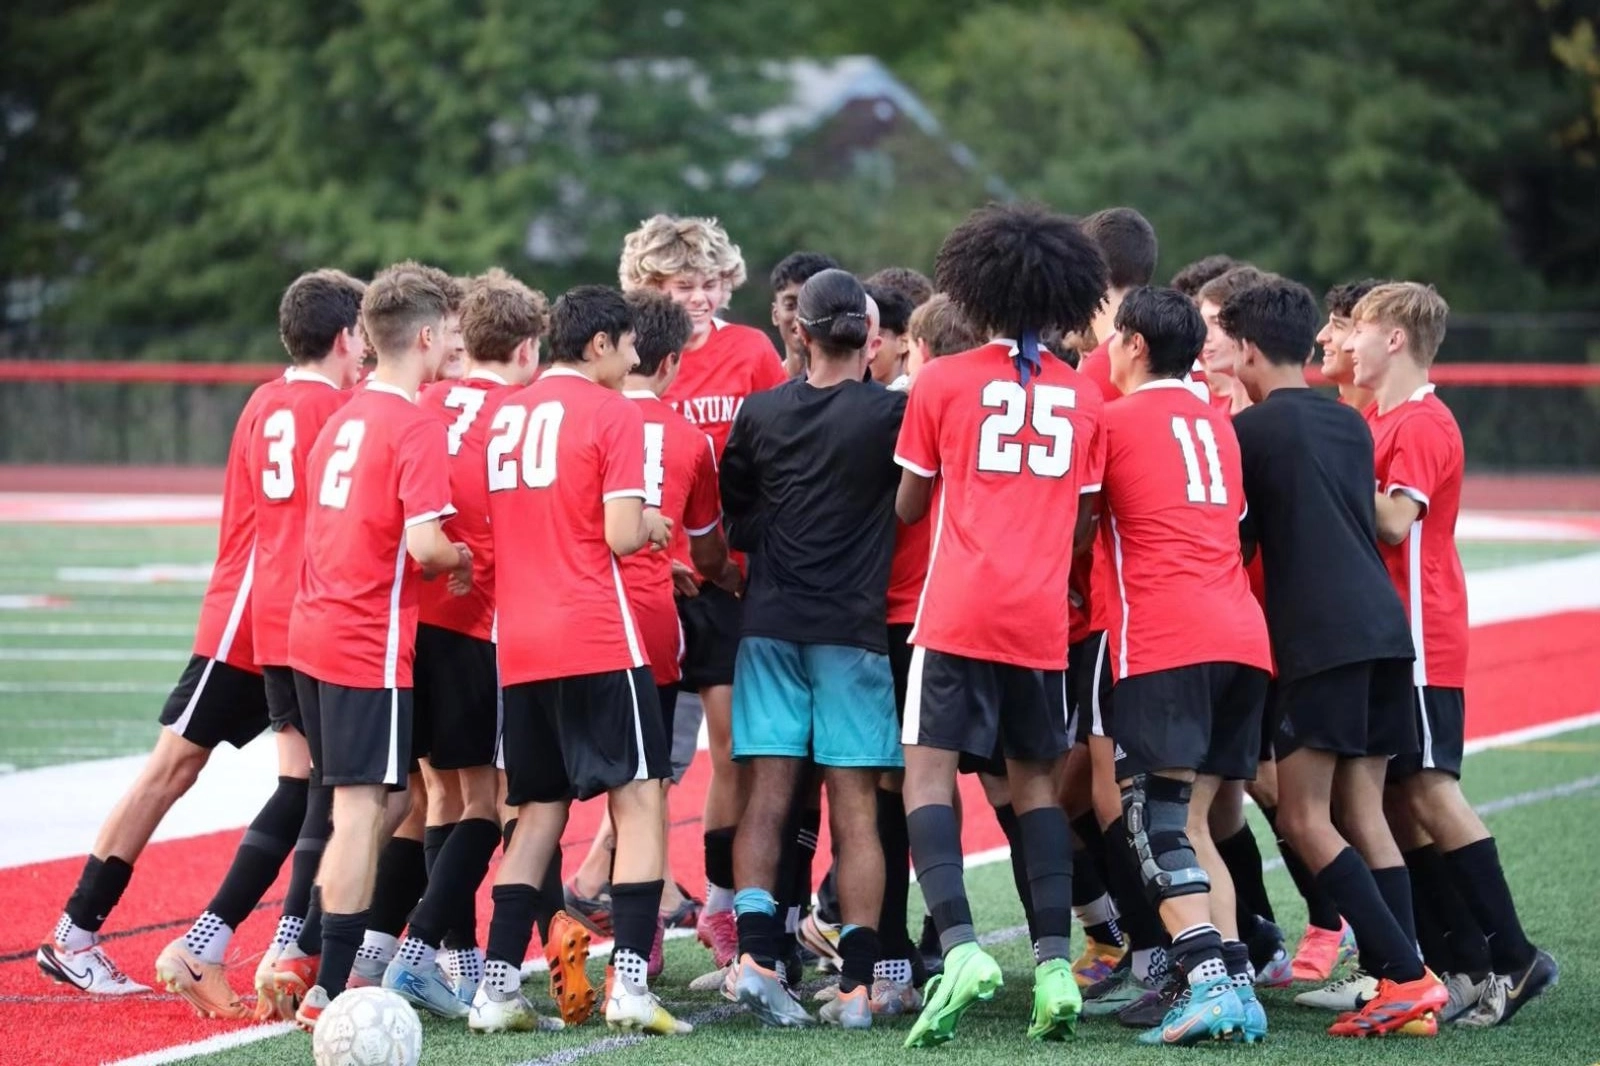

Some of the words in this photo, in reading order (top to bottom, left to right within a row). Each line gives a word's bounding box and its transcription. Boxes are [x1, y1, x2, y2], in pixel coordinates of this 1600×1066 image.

[262, 408, 296, 500] 3
[444, 386, 488, 456] 7
[486, 400, 565, 493] 20
[671, 396, 744, 424] AYUN
[977, 379, 1076, 478] 25
[319, 418, 366, 509] 2
[1171, 416, 1228, 505] 11
